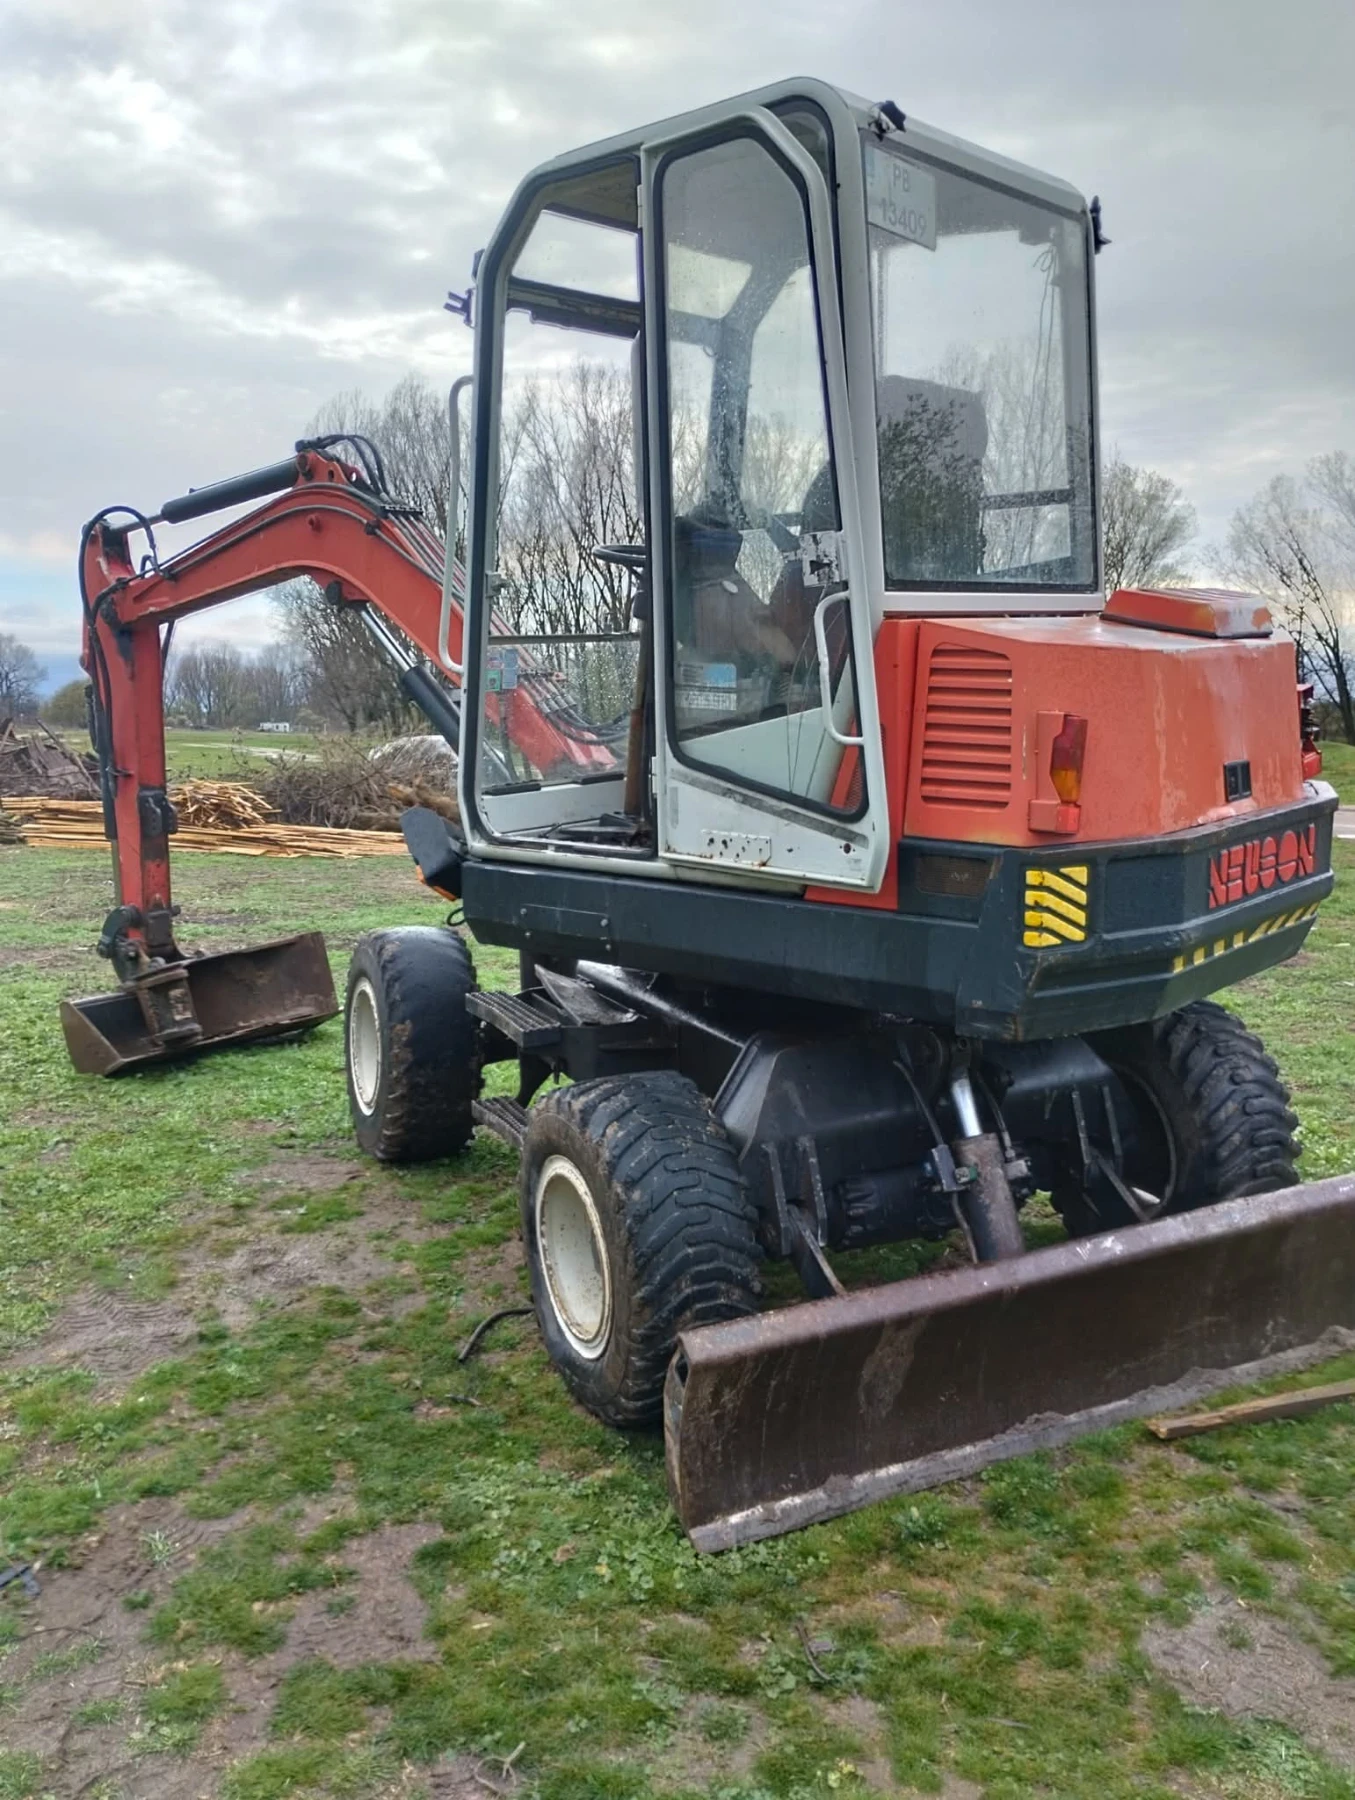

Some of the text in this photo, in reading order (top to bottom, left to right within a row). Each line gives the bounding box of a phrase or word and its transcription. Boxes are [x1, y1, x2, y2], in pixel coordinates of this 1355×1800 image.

[892, 163, 911, 192] PB
[879, 197, 927, 237] 13409
[1208, 823, 1317, 909] NEUSON
